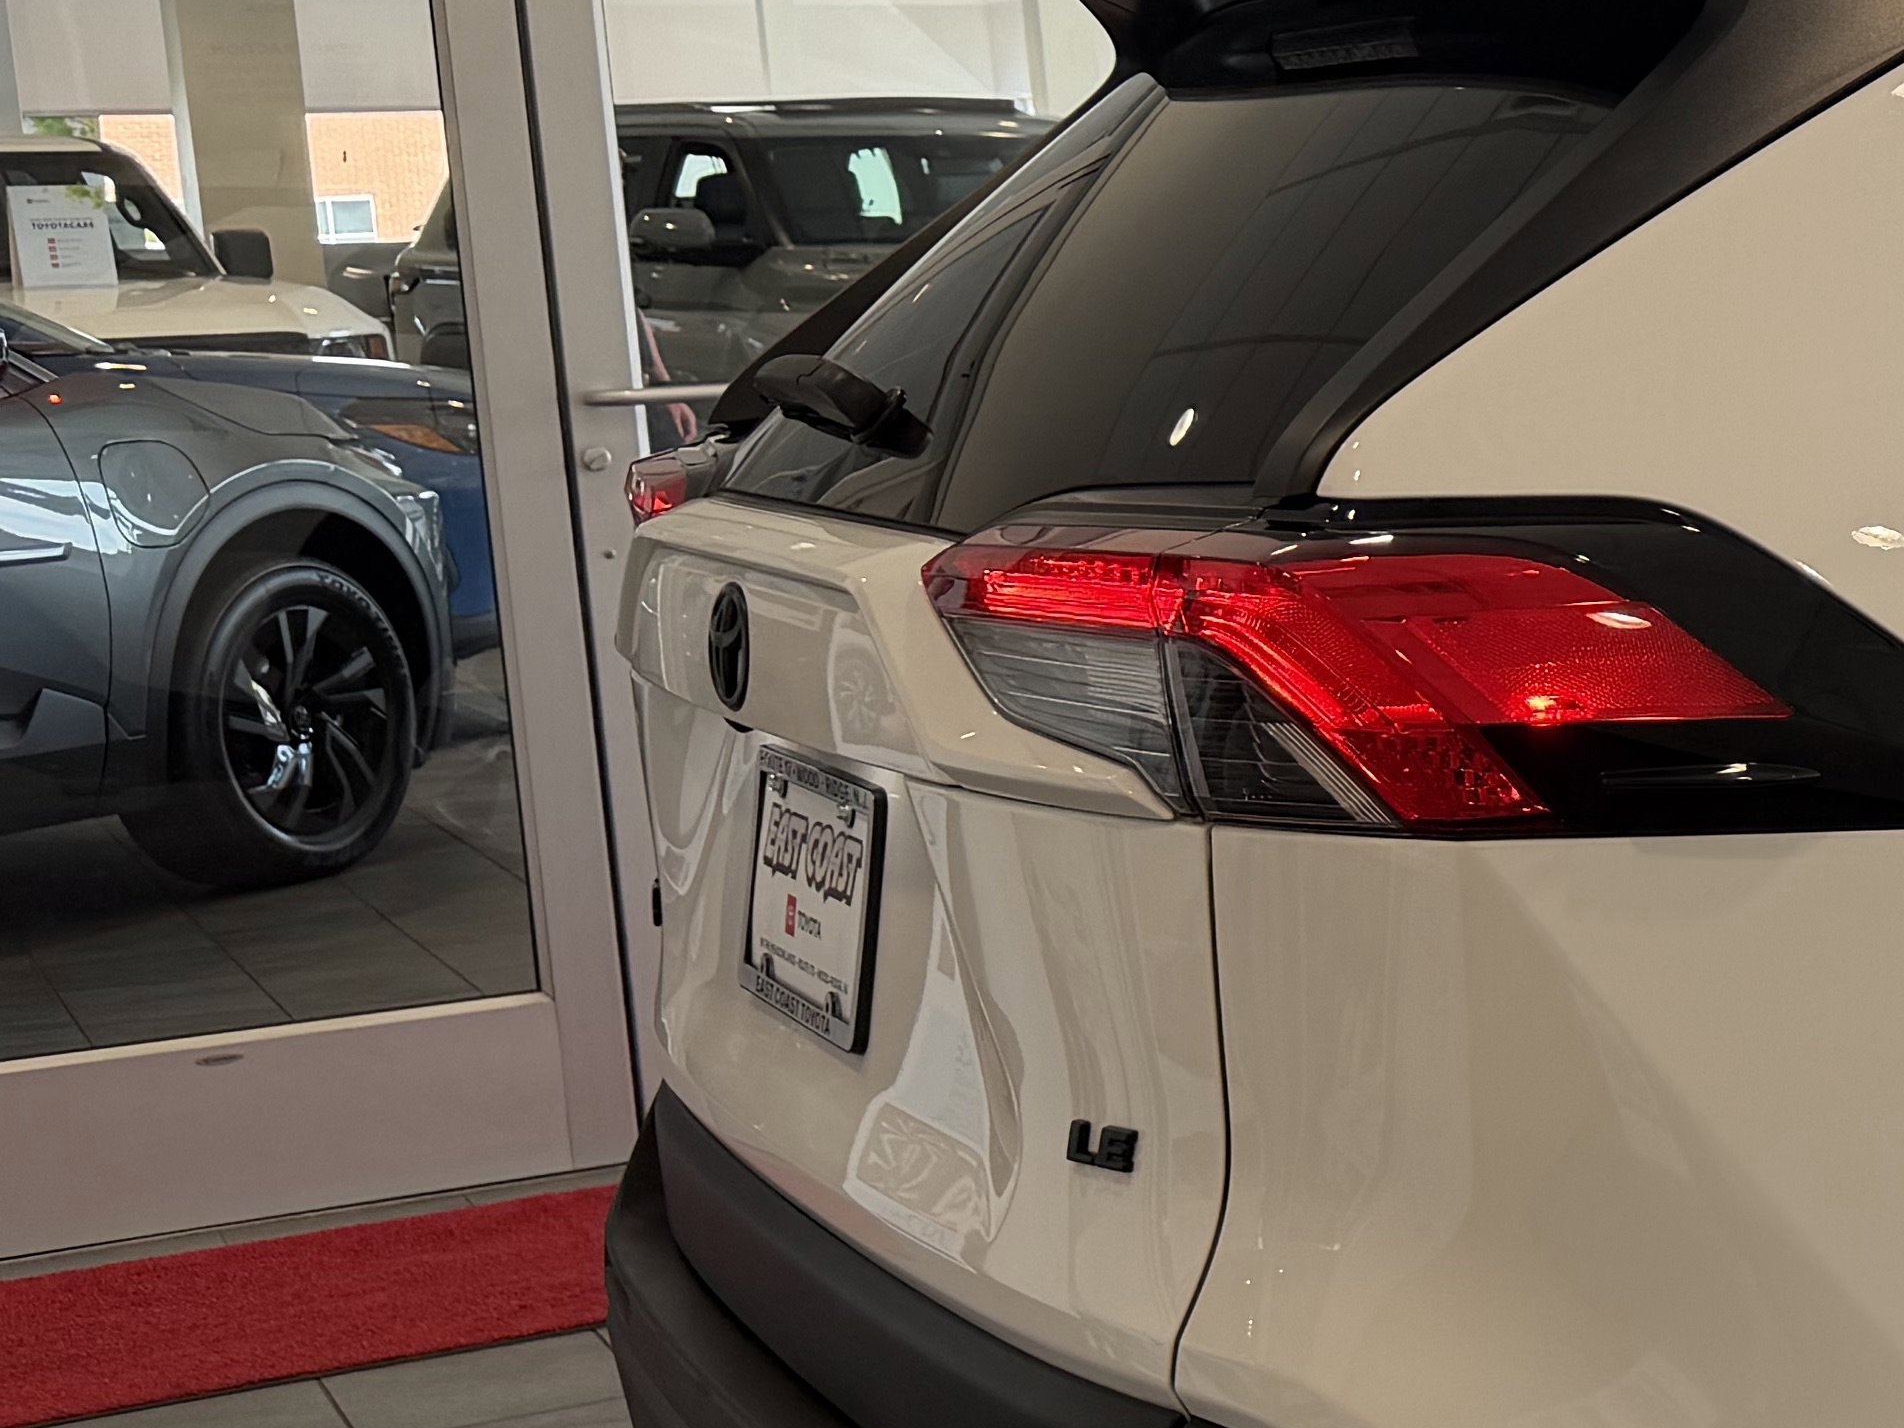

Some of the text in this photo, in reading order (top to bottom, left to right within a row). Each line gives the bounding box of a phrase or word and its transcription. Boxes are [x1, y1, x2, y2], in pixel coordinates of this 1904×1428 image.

[763, 802, 864, 907] EAST COAST
[797, 910, 822, 940] TOYOTA
[755, 974, 831, 1037] EAST COAST TOYOTA
[1066, 1119, 1139, 1173] LE
